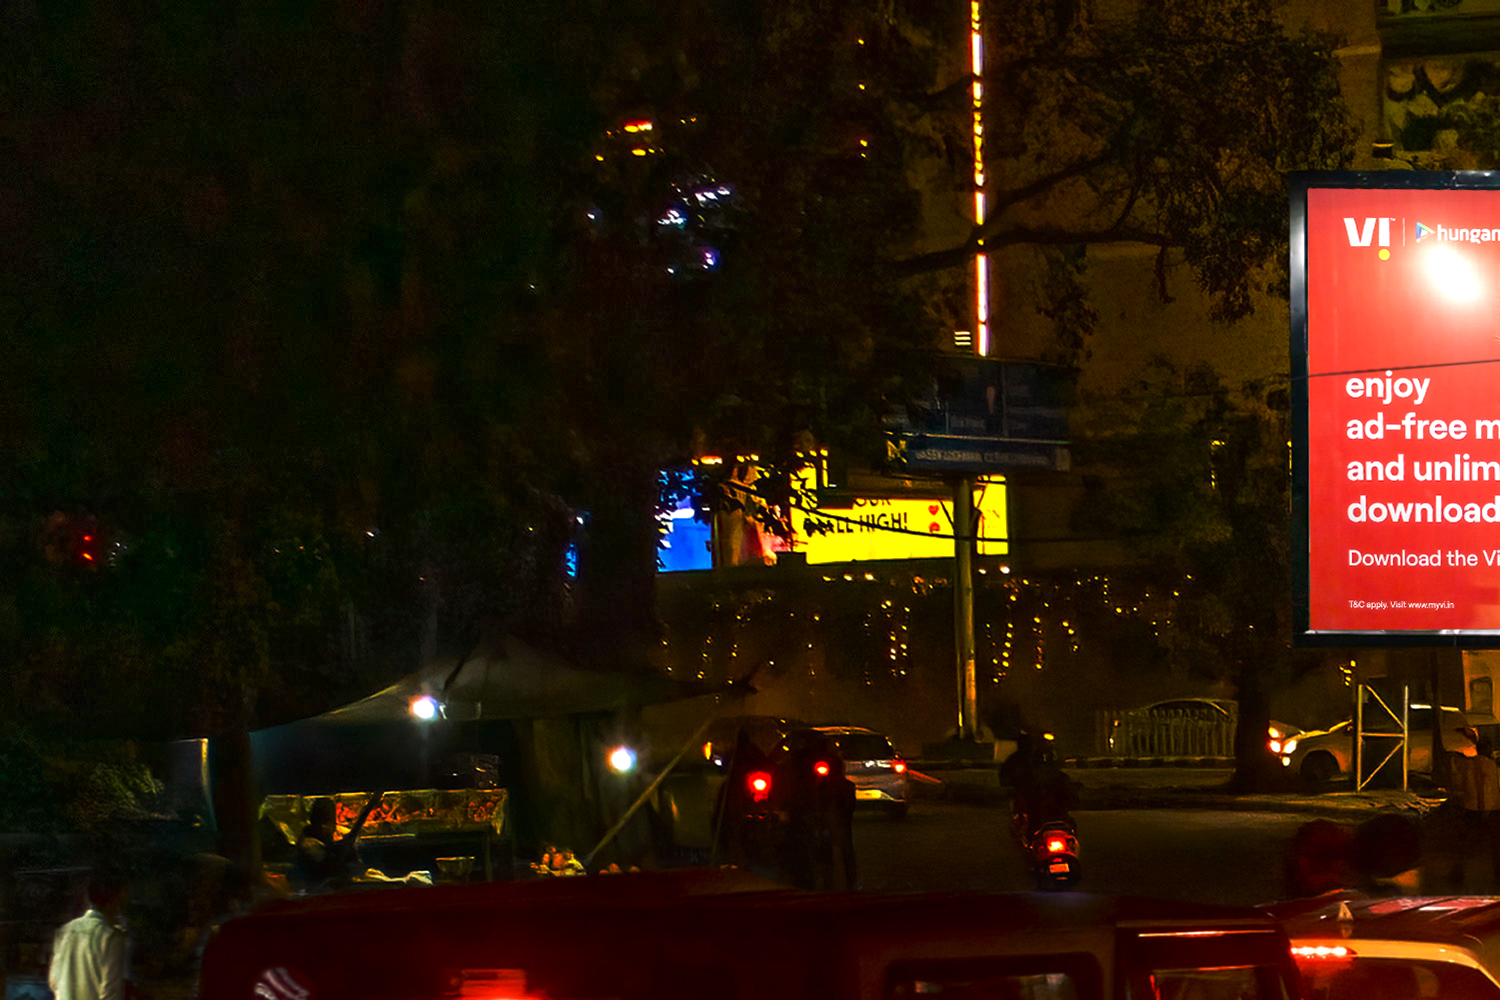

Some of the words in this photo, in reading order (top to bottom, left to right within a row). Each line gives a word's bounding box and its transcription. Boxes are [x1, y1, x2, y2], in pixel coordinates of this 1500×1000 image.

[1345, 370, 1430, 405] enjoy
[1346, 412, 1467, 440] ad-free
[1347, 454, 1405, 481] and
[1348, 549, 1441, 566] Download
[1446, 549, 1478, 566] the
[1483, 550, 1500, 566] Vi
[1349, 600, 1365, 609] T&C
[1366, 601, 1389, 610] apply.
[1390, 600, 1407, 609] Visit
[1408, 600, 1455, 610] www.myvi.in
